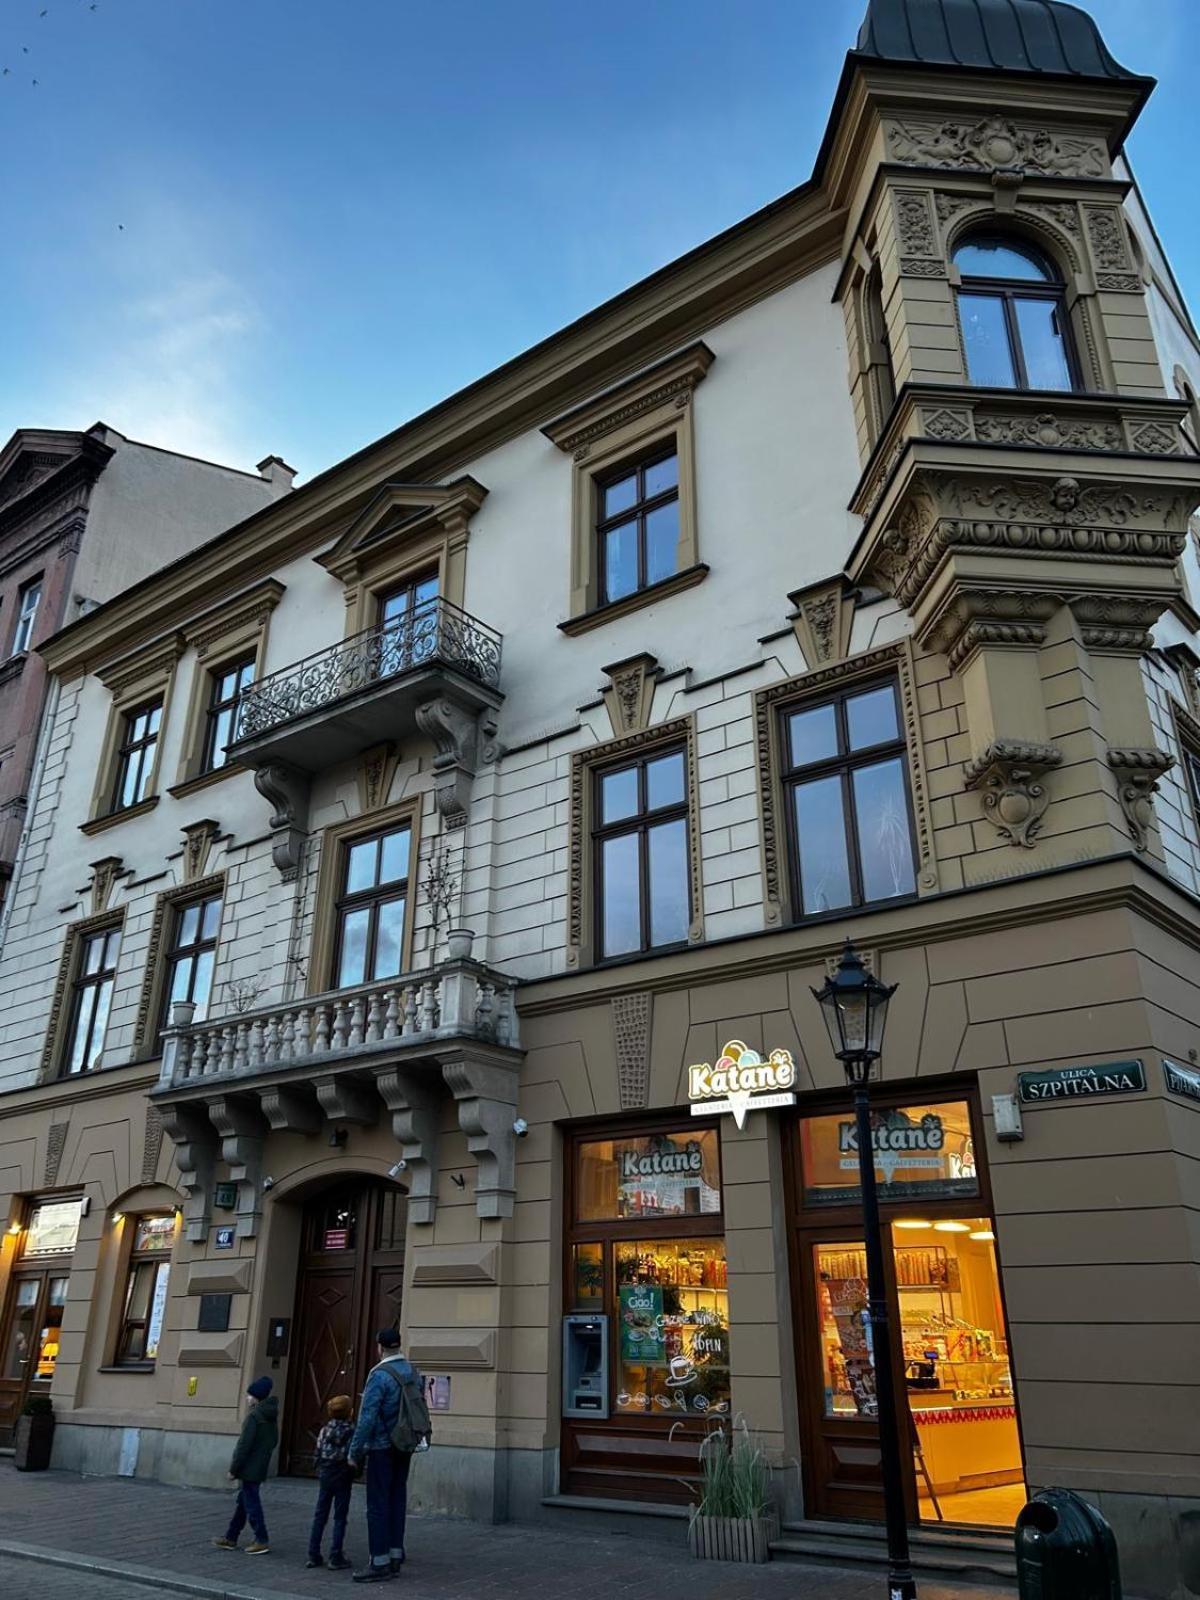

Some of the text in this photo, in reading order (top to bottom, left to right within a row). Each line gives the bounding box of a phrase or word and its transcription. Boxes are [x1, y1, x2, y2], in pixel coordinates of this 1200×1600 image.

[1060, 1068, 1096, 1079] ULICA
[1029, 1074, 1136, 1099] SZPITALNA
[706, 1337, 721, 1352] PLN
